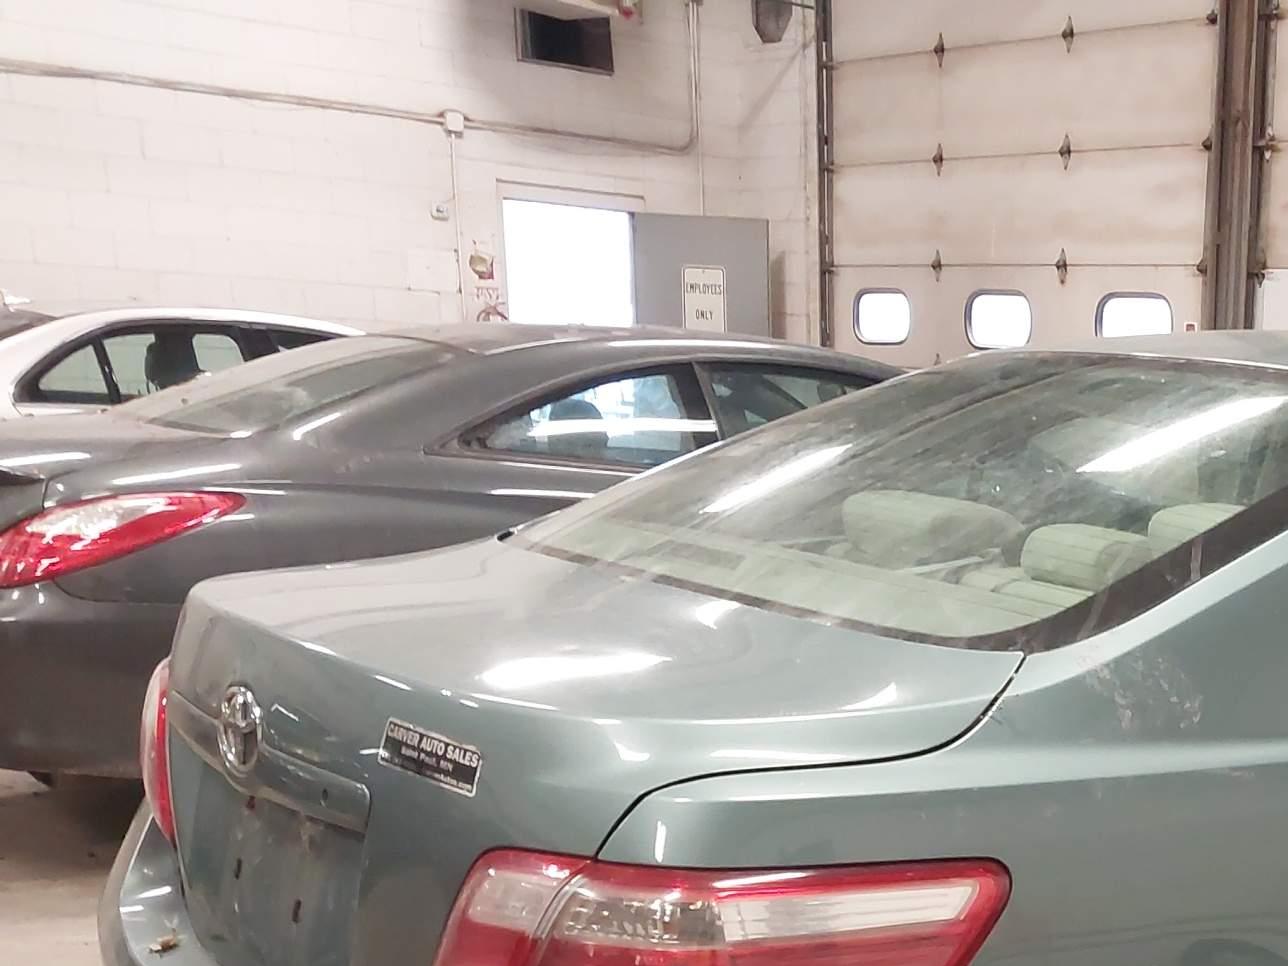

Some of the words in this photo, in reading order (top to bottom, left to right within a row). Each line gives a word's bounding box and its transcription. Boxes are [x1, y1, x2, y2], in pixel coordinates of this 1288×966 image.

[685, 282, 722, 295] EMPLOYEES
[695, 308, 713, 321] ONLY
[420, 736, 446, 756] AUTO
[446, 745, 479, 768] SALES
